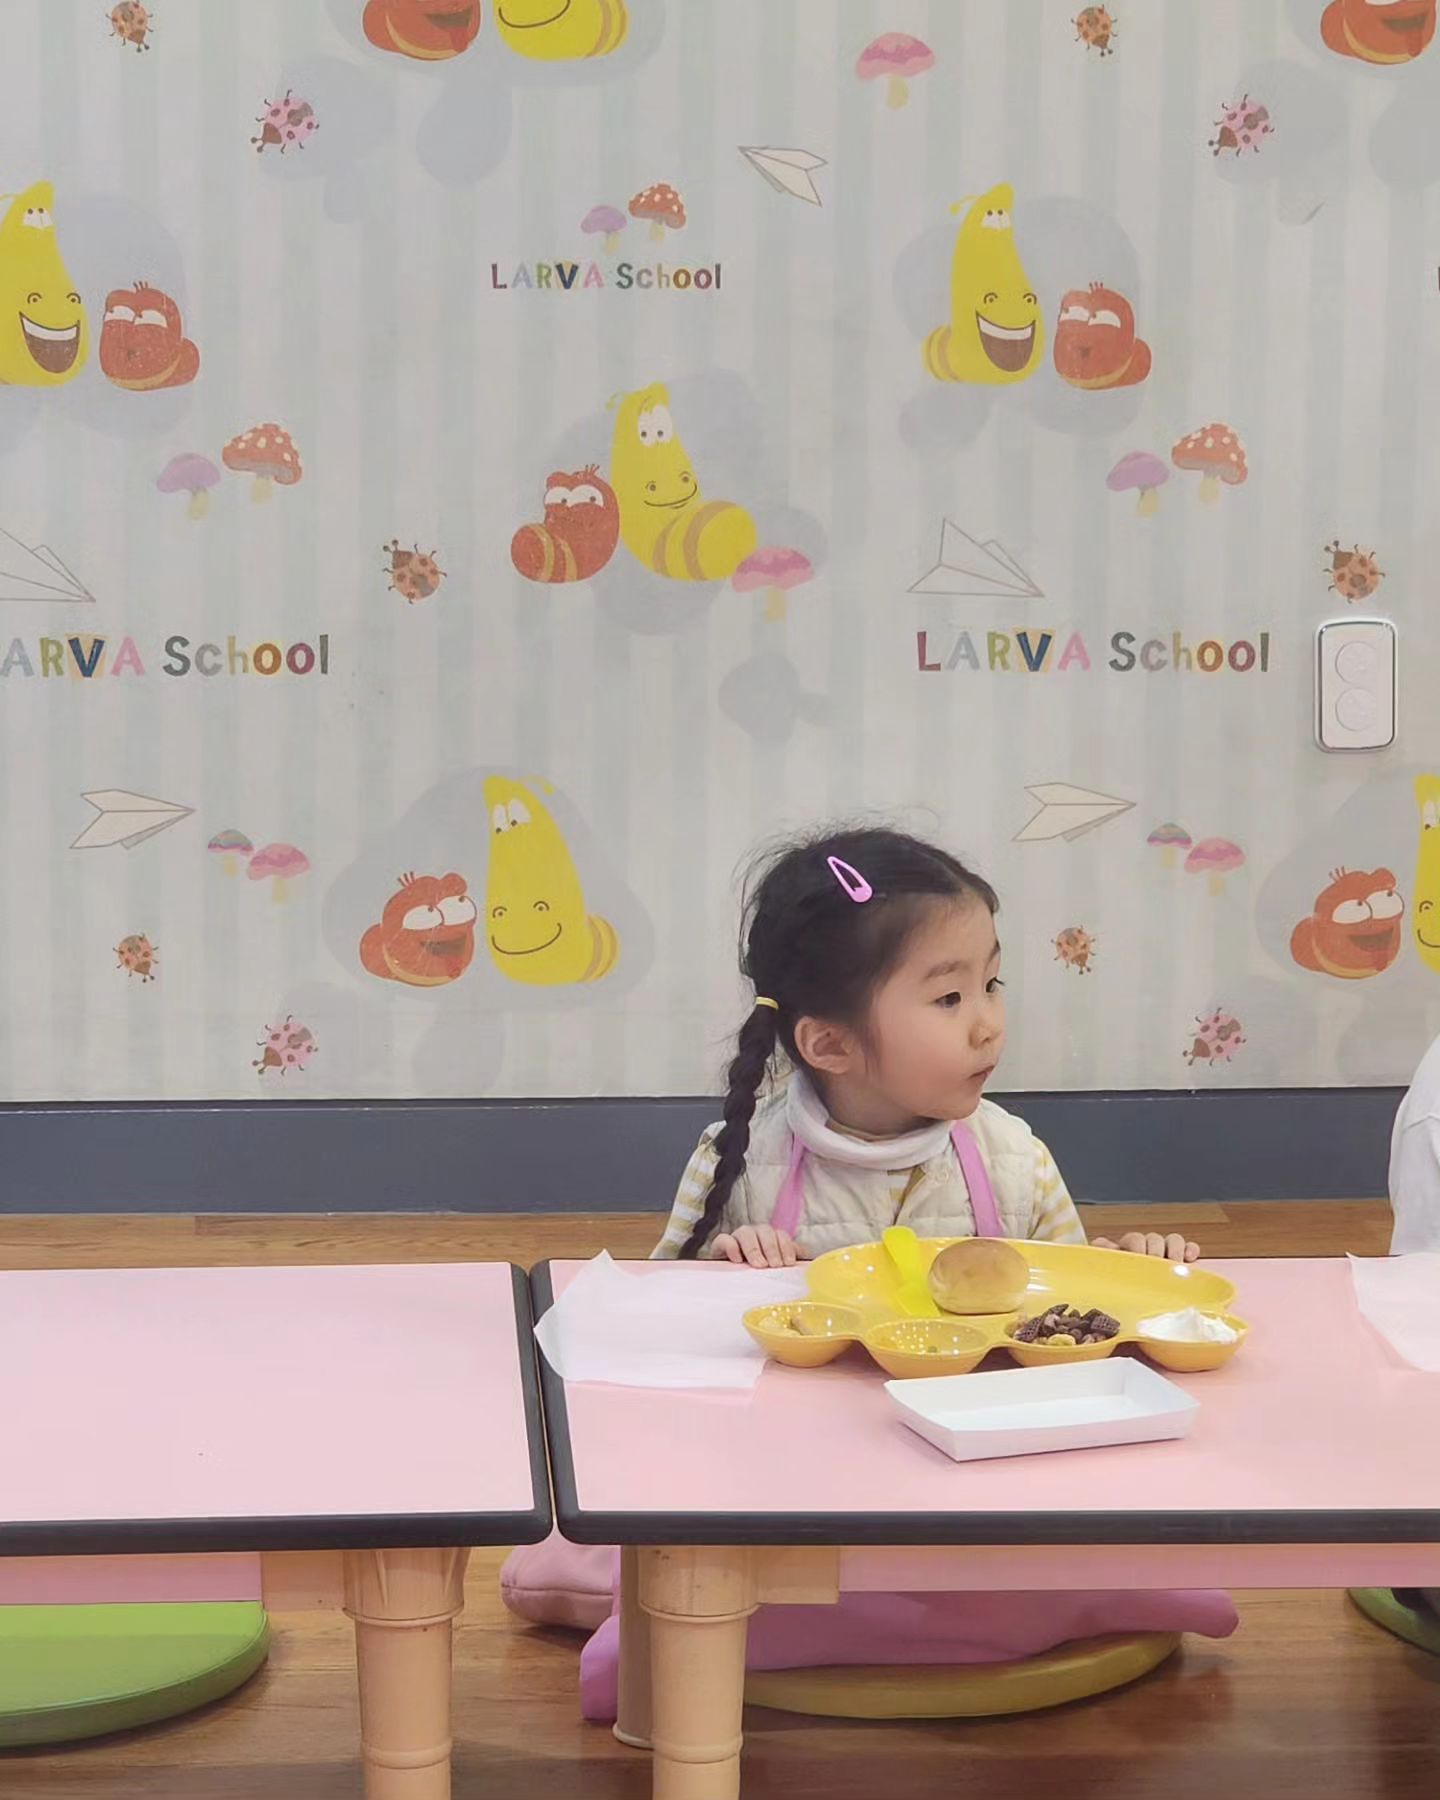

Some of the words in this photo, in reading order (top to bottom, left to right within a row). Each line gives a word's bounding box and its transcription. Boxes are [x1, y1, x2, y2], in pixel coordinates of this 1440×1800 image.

[491, 263, 604, 290] LARVA
[616, 263, 721, 290] School
[162, 634, 329, 677] School
[916, 631, 1091, 673] LARVA
[1108, 631, 1270, 673] School
